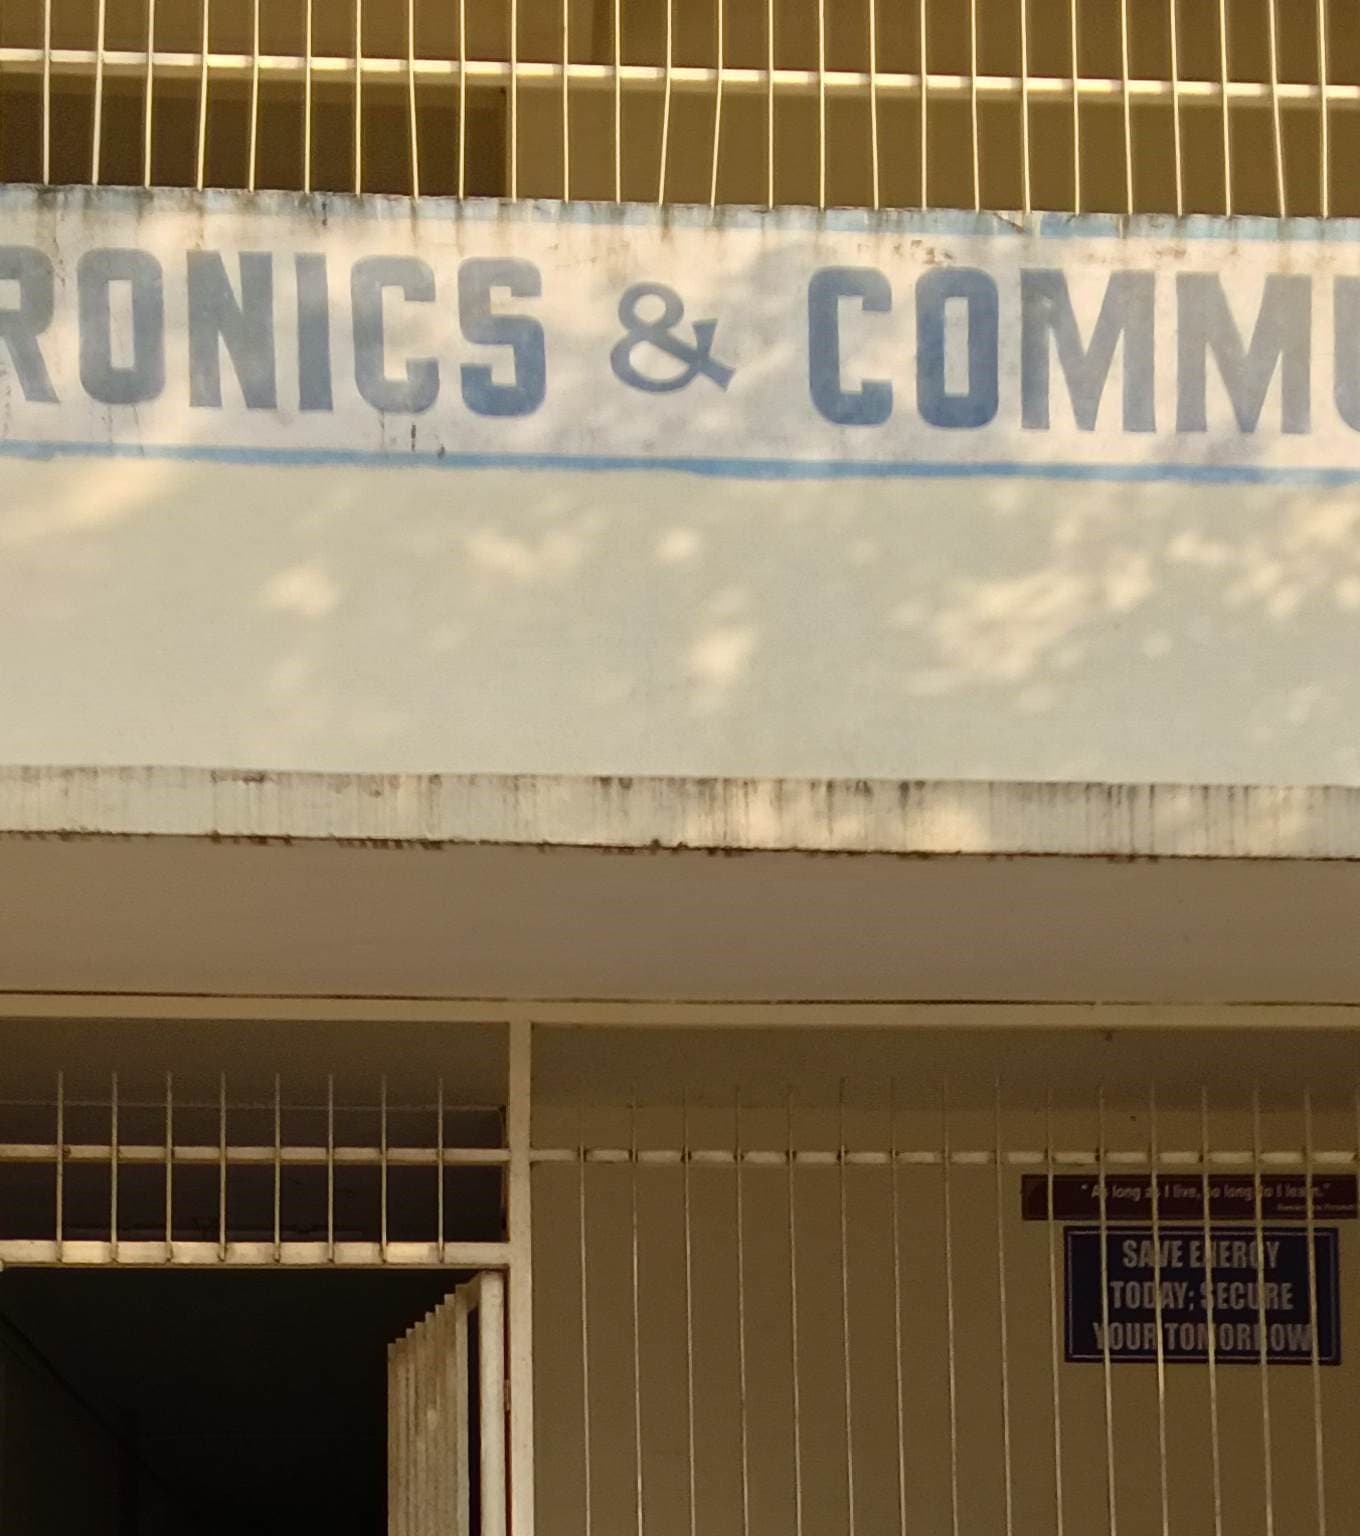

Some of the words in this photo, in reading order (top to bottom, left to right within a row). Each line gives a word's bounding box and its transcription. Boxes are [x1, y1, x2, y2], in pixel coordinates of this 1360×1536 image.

[610, 281, 738, 393] &
[1112, 1184, 1141, 1202] long
[1202, 1187, 1221, 1199] o
[1224, 1184, 1253, 1203] long
[1255, 1184, 1274, 1199] o
[1122, 1239, 1183, 1269] SAVE
[1109, 1281, 1194, 1311] TODAY;
[1200, 1281, 1294, 1310] SECURE
[1092, 1321, 1158, 1351] YOUR
